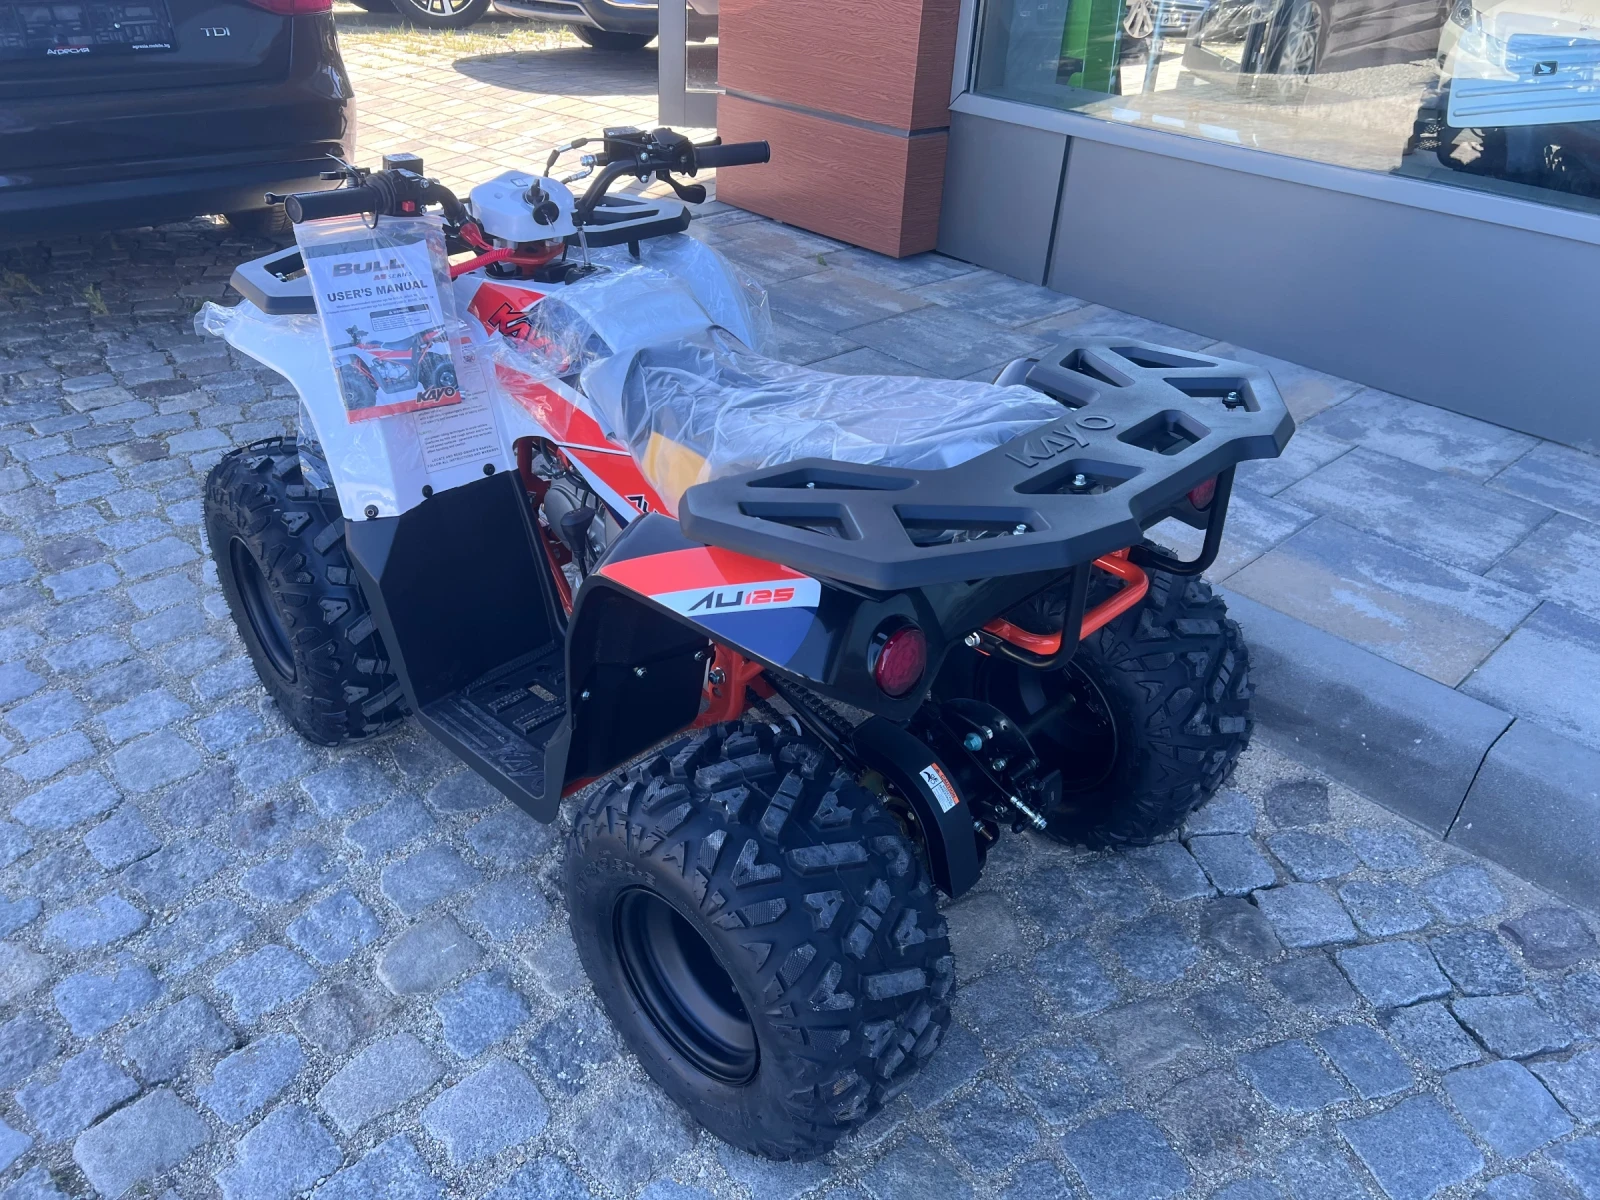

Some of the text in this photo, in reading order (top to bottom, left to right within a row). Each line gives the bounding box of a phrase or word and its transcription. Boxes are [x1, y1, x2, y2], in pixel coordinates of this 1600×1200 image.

[200, 27, 231, 37] TDI
[46, 47, 90, 56] Агресия
[332, 258, 405, 277] BULL
[327, 286, 373, 302] USER'S
[376, 280, 428, 295] MANUAL
[416, 385, 456, 404] KAYO
[1005, 415, 1116, 469] KAYO
[687, 587, 795, 611] AU125
